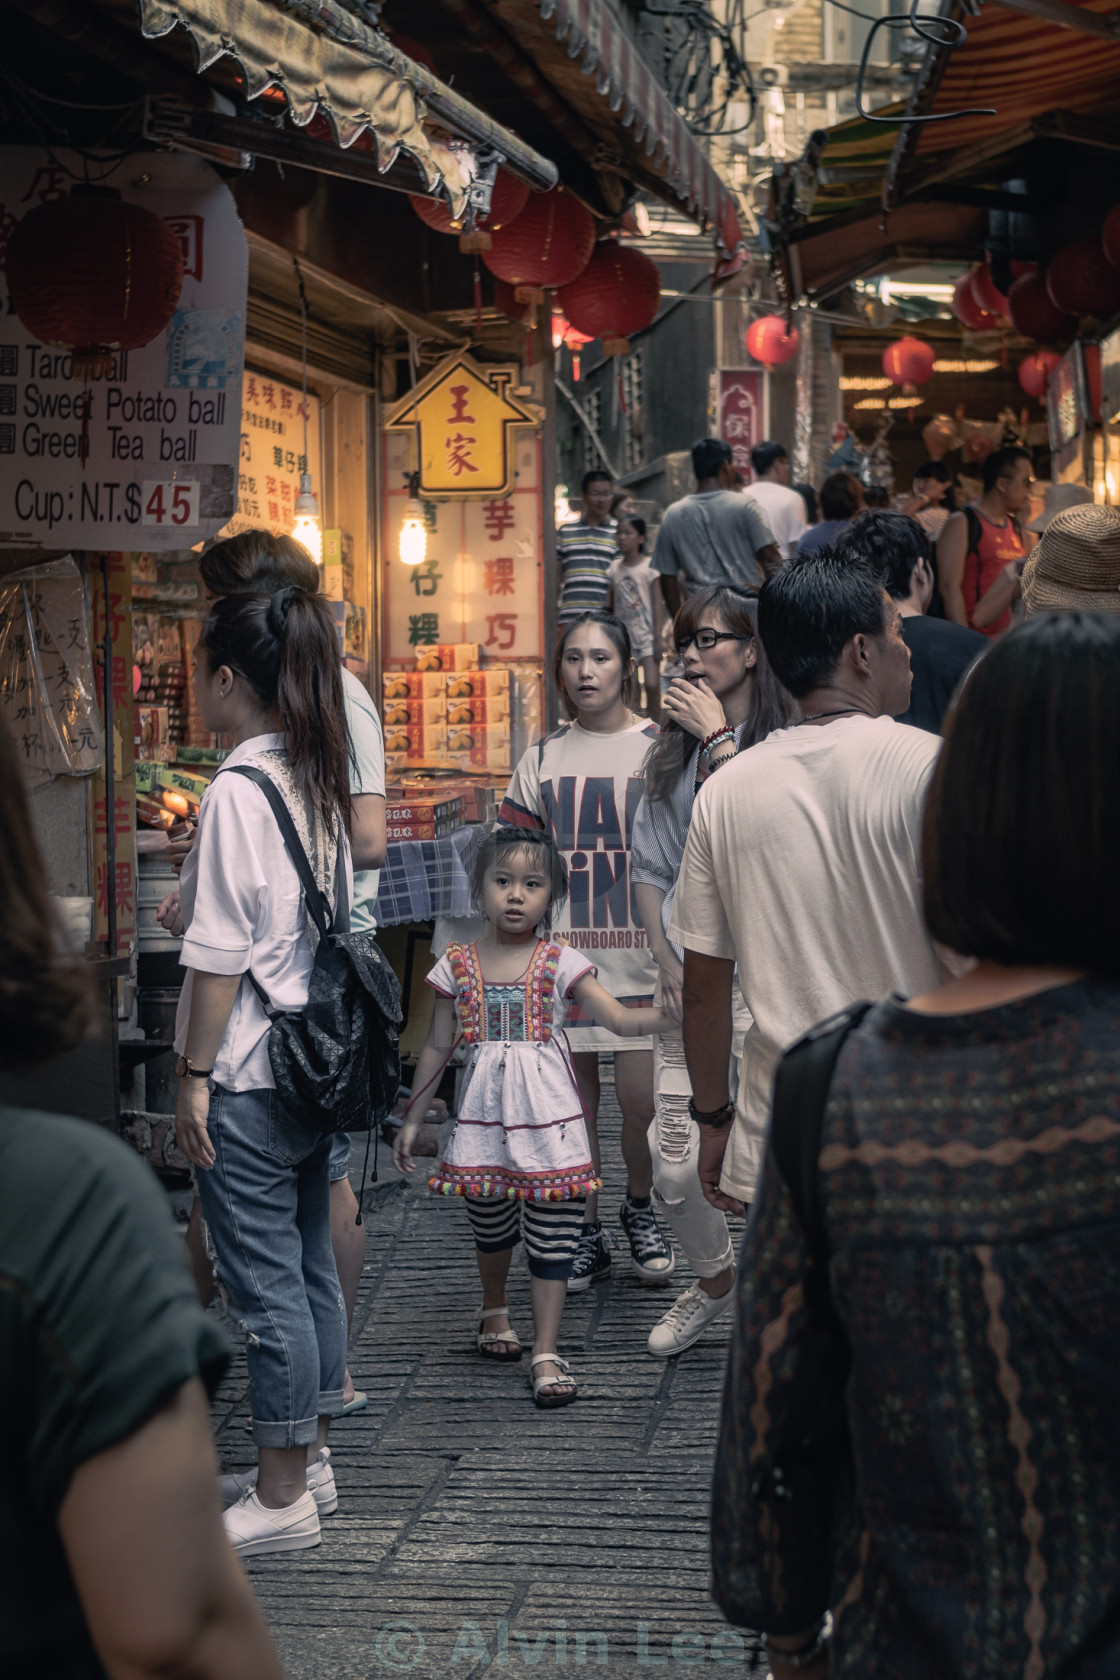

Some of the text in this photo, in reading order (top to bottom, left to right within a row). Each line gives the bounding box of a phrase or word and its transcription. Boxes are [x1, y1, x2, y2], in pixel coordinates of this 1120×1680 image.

[24, 384, 94, 420] Sweet
[107, 388, 177, 423] Potato
[188, 391, 226, 425] ball
[23, 422, 197, 462] Green Tea ball
[445, 384, 480, 478] 王家
[15, 480, 73, 529] Cup:
[482, 498, 518, 651] 芋粿巧
